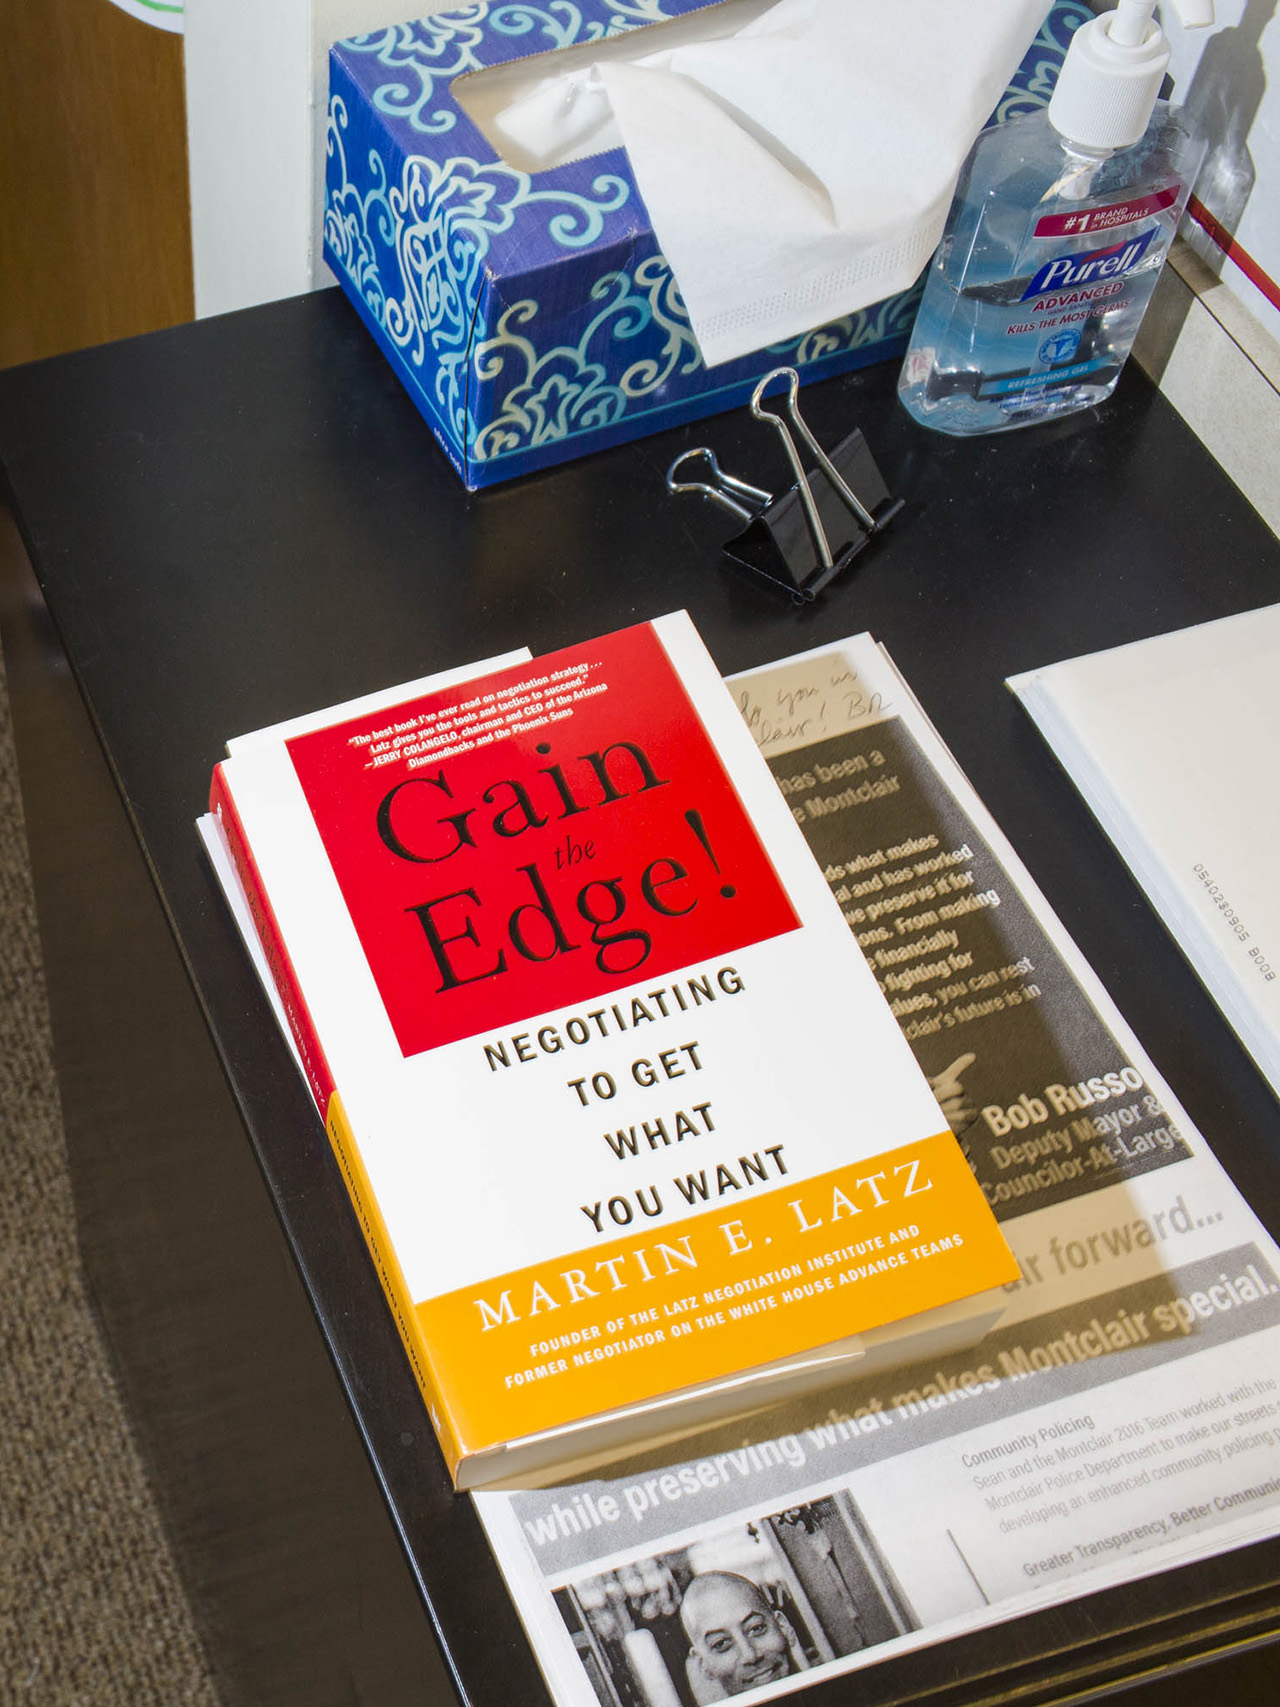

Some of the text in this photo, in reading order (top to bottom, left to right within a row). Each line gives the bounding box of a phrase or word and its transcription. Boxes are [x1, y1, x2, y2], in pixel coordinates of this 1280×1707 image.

[1064, 214, 1091, 232] #1
[1094, 207, 1128, 221] BRAND
[1099, 208, 1150, 227] HOSPITALS
[1032, 281, 1124, 312] ADVANCED
[1040, 241, 1143, 289] Purell
[1007, 322, 1036, 335] KILLS
[1039, 317, 1058, 329] THE
[1059, 310, 1091, 325] MOST
[370, 740, 391, 754] Latz
[392, 733, 418, 750] gives
[418, 725, 435, 740] you
[435, 719, 453, 734] the
[453, 712, 479, 728] tools
[479, 705, 497, 721] and
[497, 692, 531, 714] tactics
[531, 689, 544, 704] to
[372, 725, 394, 741] best
[394, 717, 418, 735] book
[437, 705, 459, 721] ever
[460, 698, 482, 714] read
[483, 692, 496, 705] on
[497, 674, 550, 701] negotiation
[403, 731, 462, 756] COLANGELO,
[462, 716, 505, 737] chairman
[505, 709, 524, 724] and
[523, 703, 544, 718] CEO
[545, 698, 557, 712] of
[556, 692, 573, 708] the
[573, 682, 608, 702] Arizona
[408, 706, 574, 769] Diamondbacks and the Phoenix Suns
[375, 740, 670, 865] Gain
[776, 750, 886, 795] has been a
[805, 774, 901, 819] Montclair
[554, 835, 597, 871] the
[845, 850, 888, 876] what
[886, 834, 940, 861] makes
[851, 873, 884, 898] and
[881, 866, 914, 887] has
[913, 844, 974, 877] worked
[405, 808, 737, 994] Edge!
[865, 883, 937, 922] preserve
[933, 873, 952, 896] it
[949, 870, 974, 891] for
[893, 889, 1001, 936] From making
[875, 929, 960, 968] financially
[884, 960, 952, 992] fighting
[947, 951, 974, 972] for
[934, 981, 969, 1006] you
[968, 970, 1001, 991] can
[999, 956, 1036, 983] rest
[953, 983, 1042, 1024] future is in
[483, 966, 746, 1072] NEGOTIATING
[567, 1040, 703, 1107] TO GET
[981, 1066, 1144, 1137] Bob Russo
[604, 1101, 716, 1161] WHAT
[990, 1128, 1073, 1169] Deputy
[1070, 1104, 1142, 1142] Mayor
[580, 1144, 789, 1233] YOU WANT
[329, 1119, 426, 1388] NEGOTIATING TO GET WHAT YOU WANT
[474, 1159, 933, 1331] MARTIN E. LATZ
[1049, 1195, 1225, 1276] forward...
[504, 1233, 964, 1389] FORMER NEGOTIATOR ON THE WHITE HOUSE ADVANCE TEAMS
[530, 1224, 921, 1356] FOUNDER OF THE LATZ NEGOTIATION INSTITUTE AND
[526, 1263, 1279, 1546] while preserving what makes Montclair special.
[973, 1377, 1277, 1491] Sean and the Montclair 2016 Team worked with the
[961, 1412, 1096, 1469] Community Policing
[985, 1401, 1278, 1512] Montclair Police Department to make our streets
[999, 1498, 1070, 1535] developing
[1069, 1494, 1088, 1510] an
[1087, 1470, 1152, 1503] enhanced
[1151, 1446, 1224, 1482] community
[1222, 1430, 1276, 1459] policing
[1022, 1550, 1075, 1578] Greater
[1170, 1498, 1214, 1528] Better
